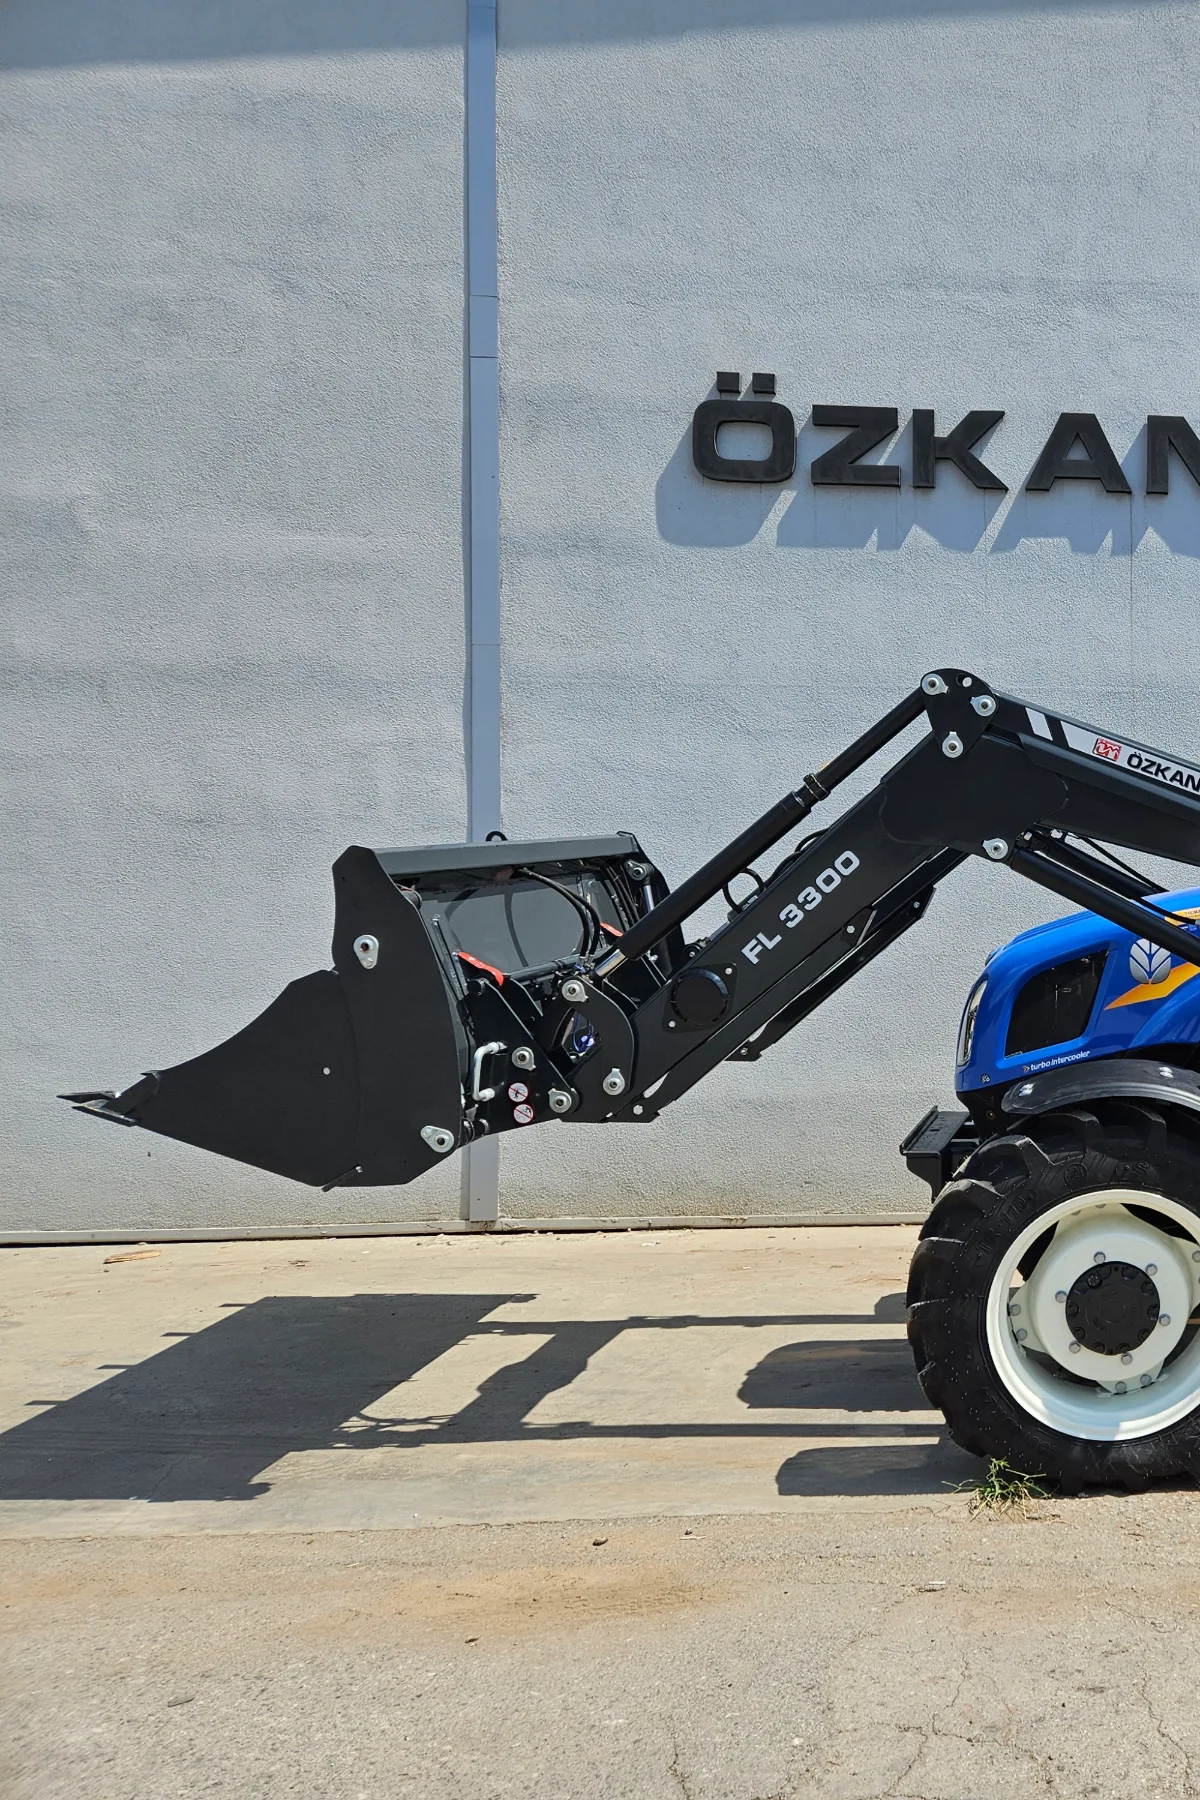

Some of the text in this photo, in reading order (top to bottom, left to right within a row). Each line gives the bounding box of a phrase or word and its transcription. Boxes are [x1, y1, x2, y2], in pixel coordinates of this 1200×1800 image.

[740, 850, 861, 965] FL 3300
[1030, 1050, 1091, 1071] turbo intercooler
